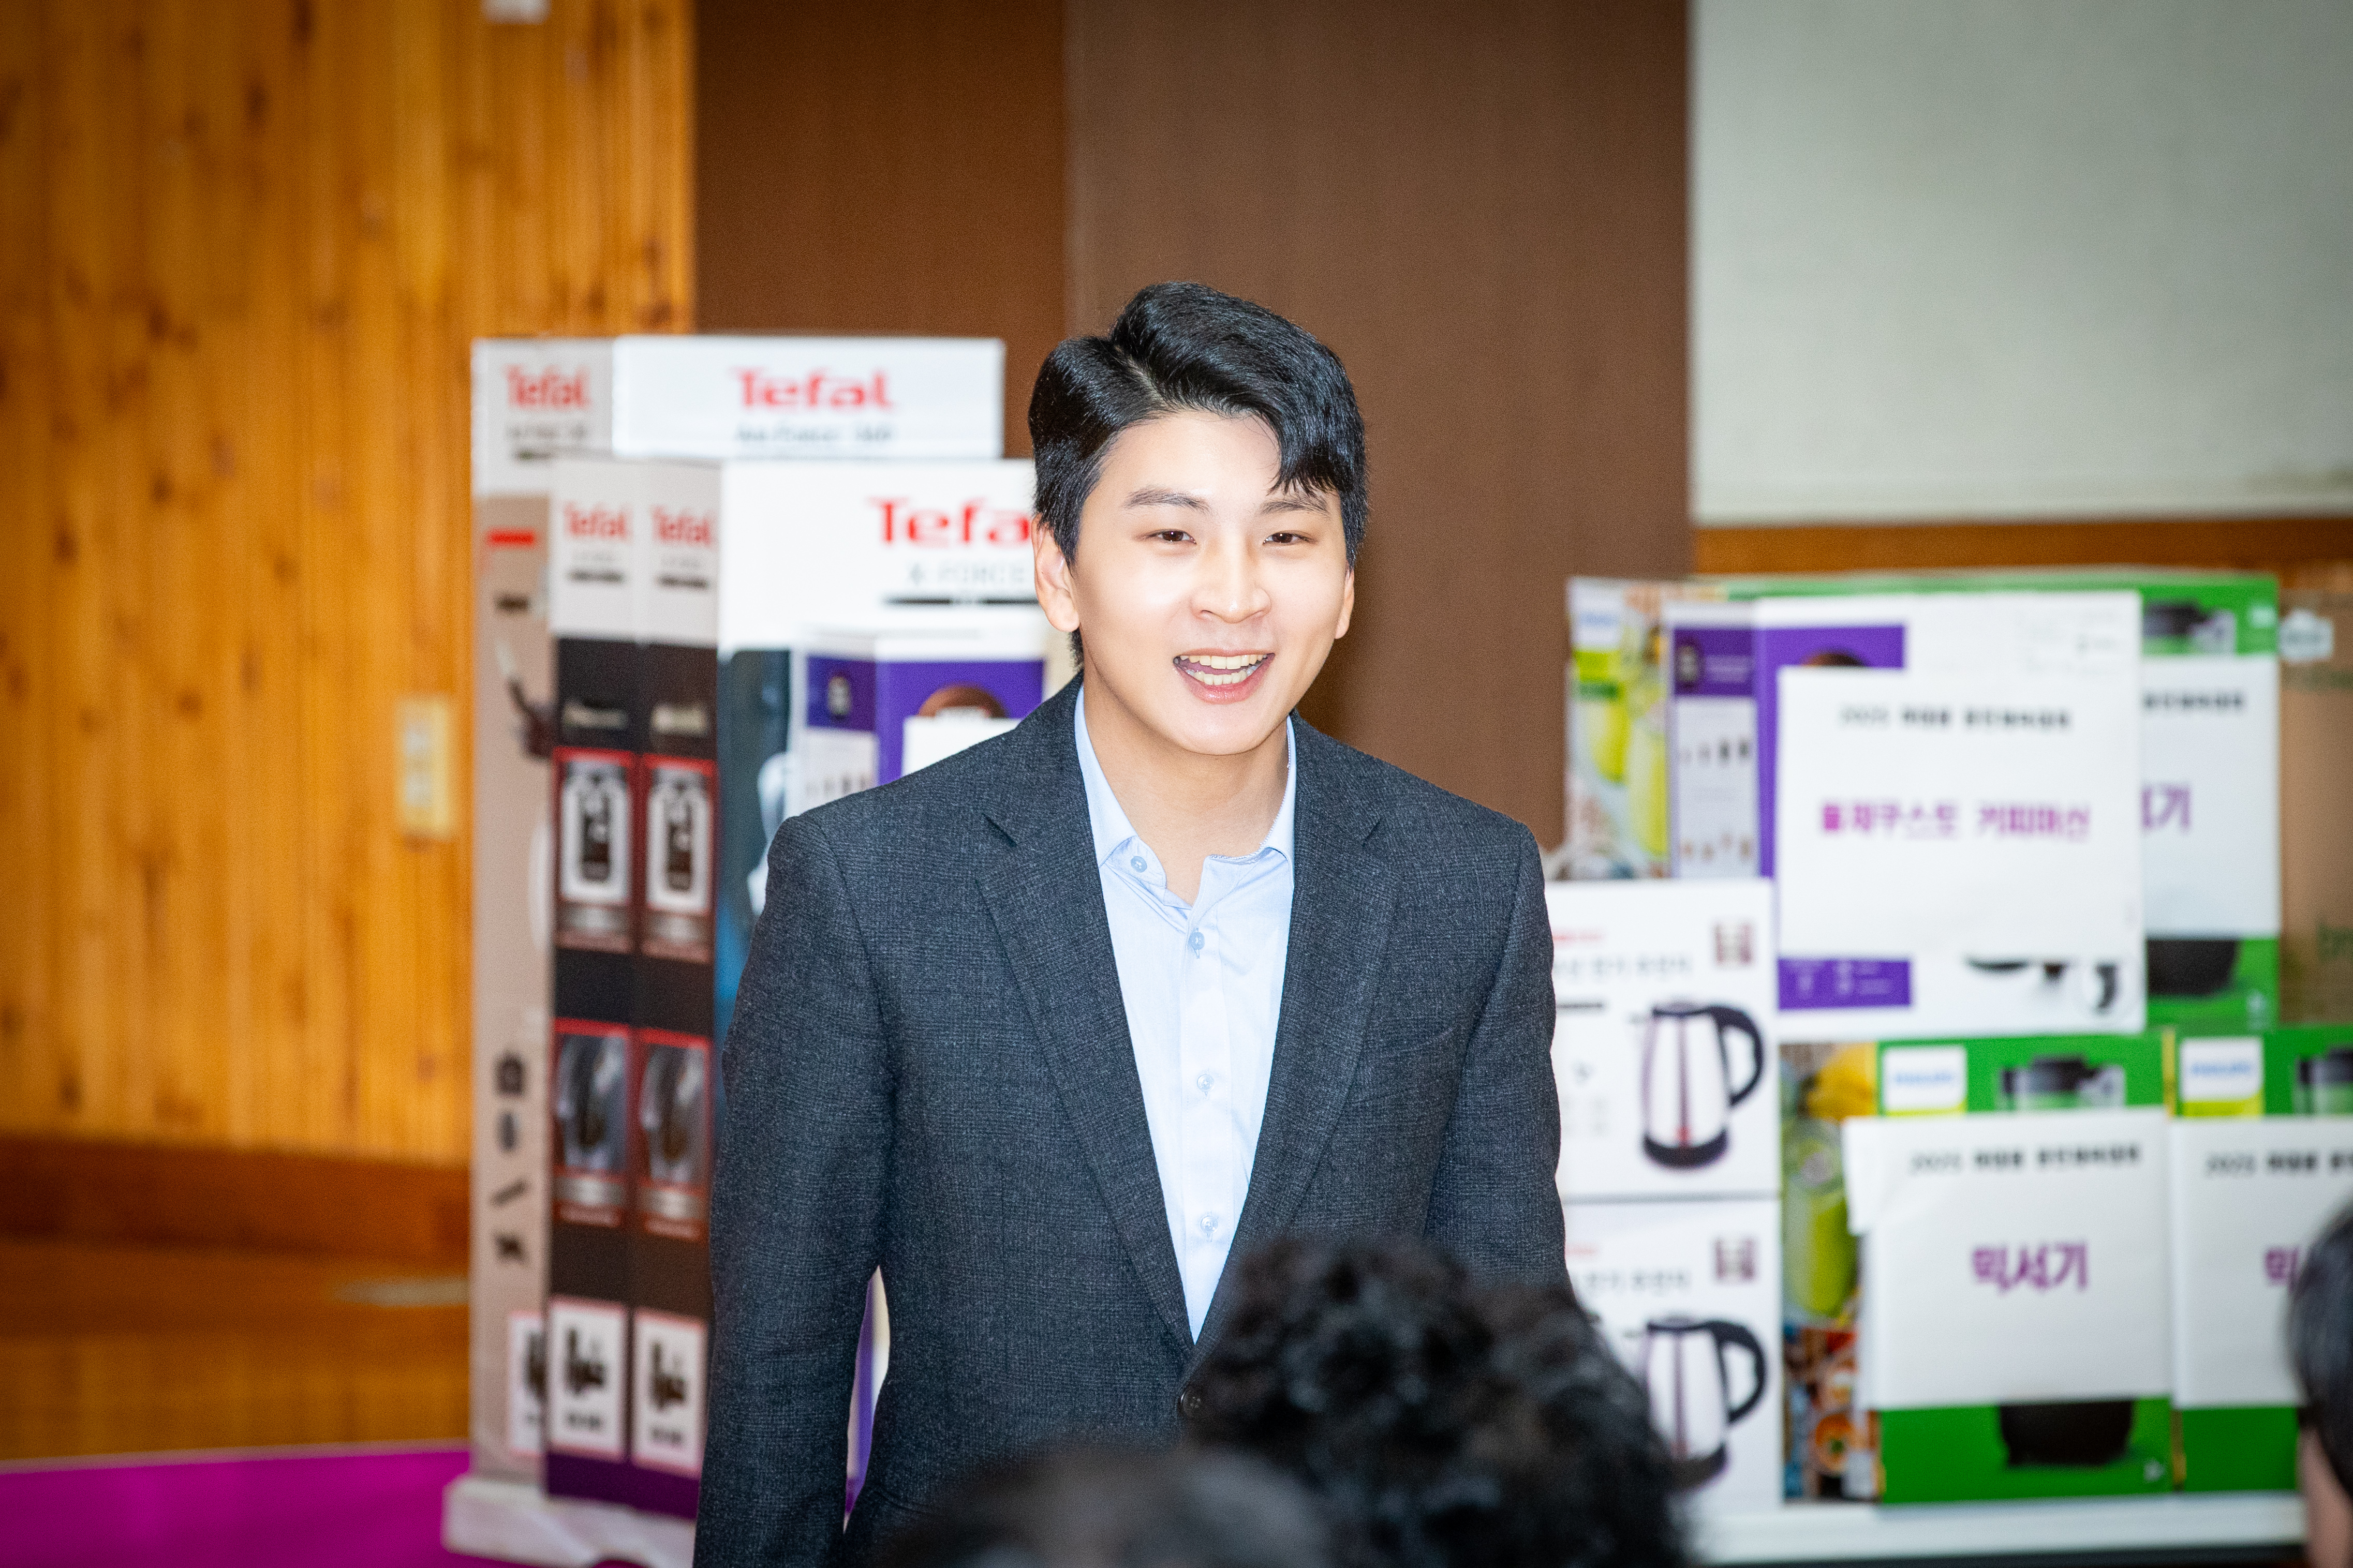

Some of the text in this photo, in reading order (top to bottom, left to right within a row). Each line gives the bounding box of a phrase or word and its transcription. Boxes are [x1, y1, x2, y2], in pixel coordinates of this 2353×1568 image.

[505, 364, 591, 411] Tefal
[732, 366, 894, 411] Tefal
[563, 502, 632, 543] Tefal
[650, 505, 717, 549] Tefal
[870, 498, 1031, 546] Tefa
[1972, 1241, 2089, 1293] 믹서기
[2263, 1246, 2302, 1291] 믹
